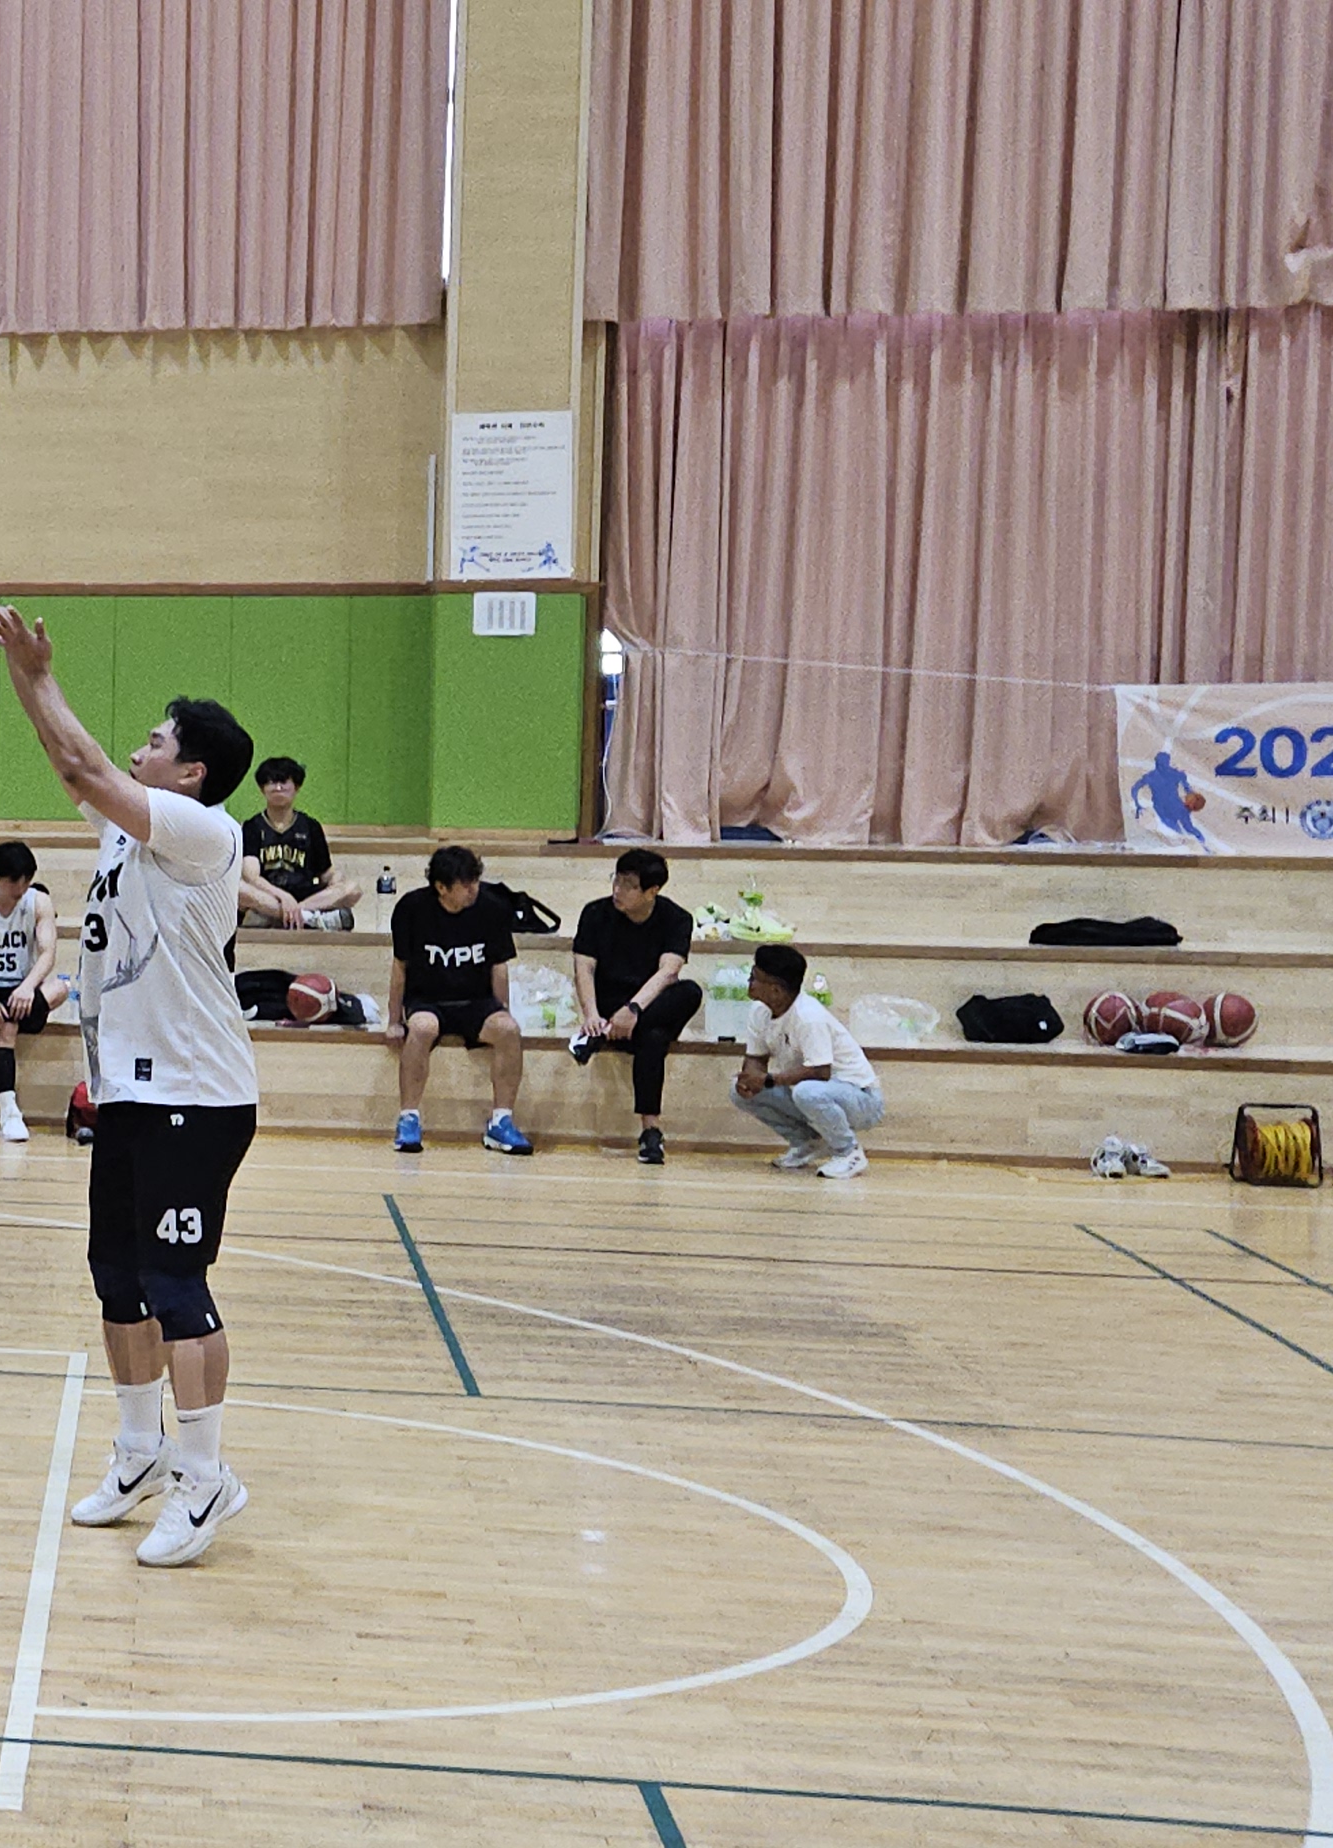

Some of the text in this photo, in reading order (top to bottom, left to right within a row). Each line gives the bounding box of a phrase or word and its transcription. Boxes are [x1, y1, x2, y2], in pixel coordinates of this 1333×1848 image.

[83, 912, 108, 953] 3
[424, 943, 485, 967] TYPE
[156, 1207, 202, 1244] 43
